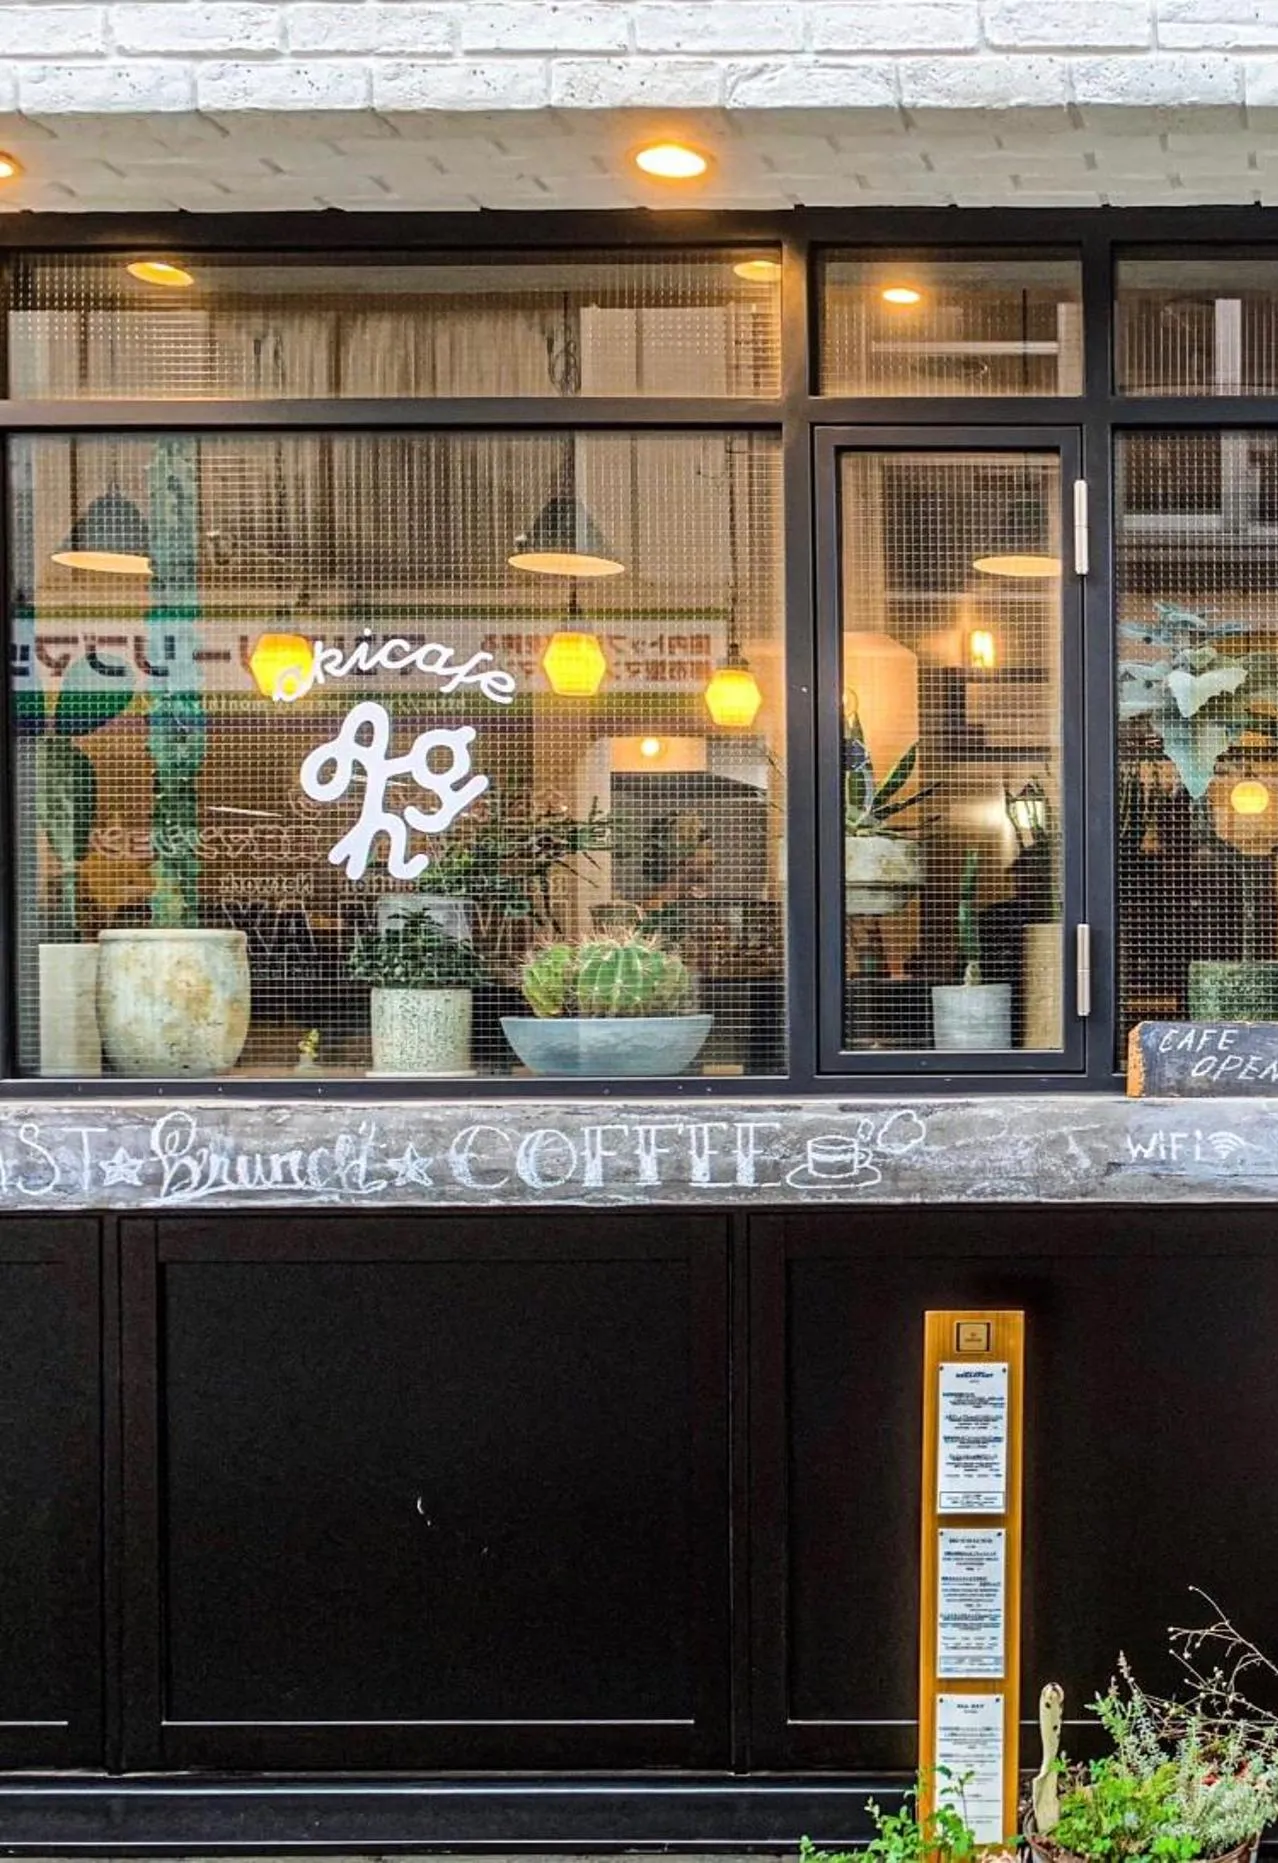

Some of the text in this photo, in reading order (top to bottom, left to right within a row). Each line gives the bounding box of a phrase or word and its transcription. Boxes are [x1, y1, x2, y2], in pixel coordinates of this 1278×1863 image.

[272, 628, 517, 704] akicafe
[1159, 1029, 1238, 1053] CAFE
[0, 1122, 107, 1196] ST
[450, 1122, 782, 1189] COFFEE
